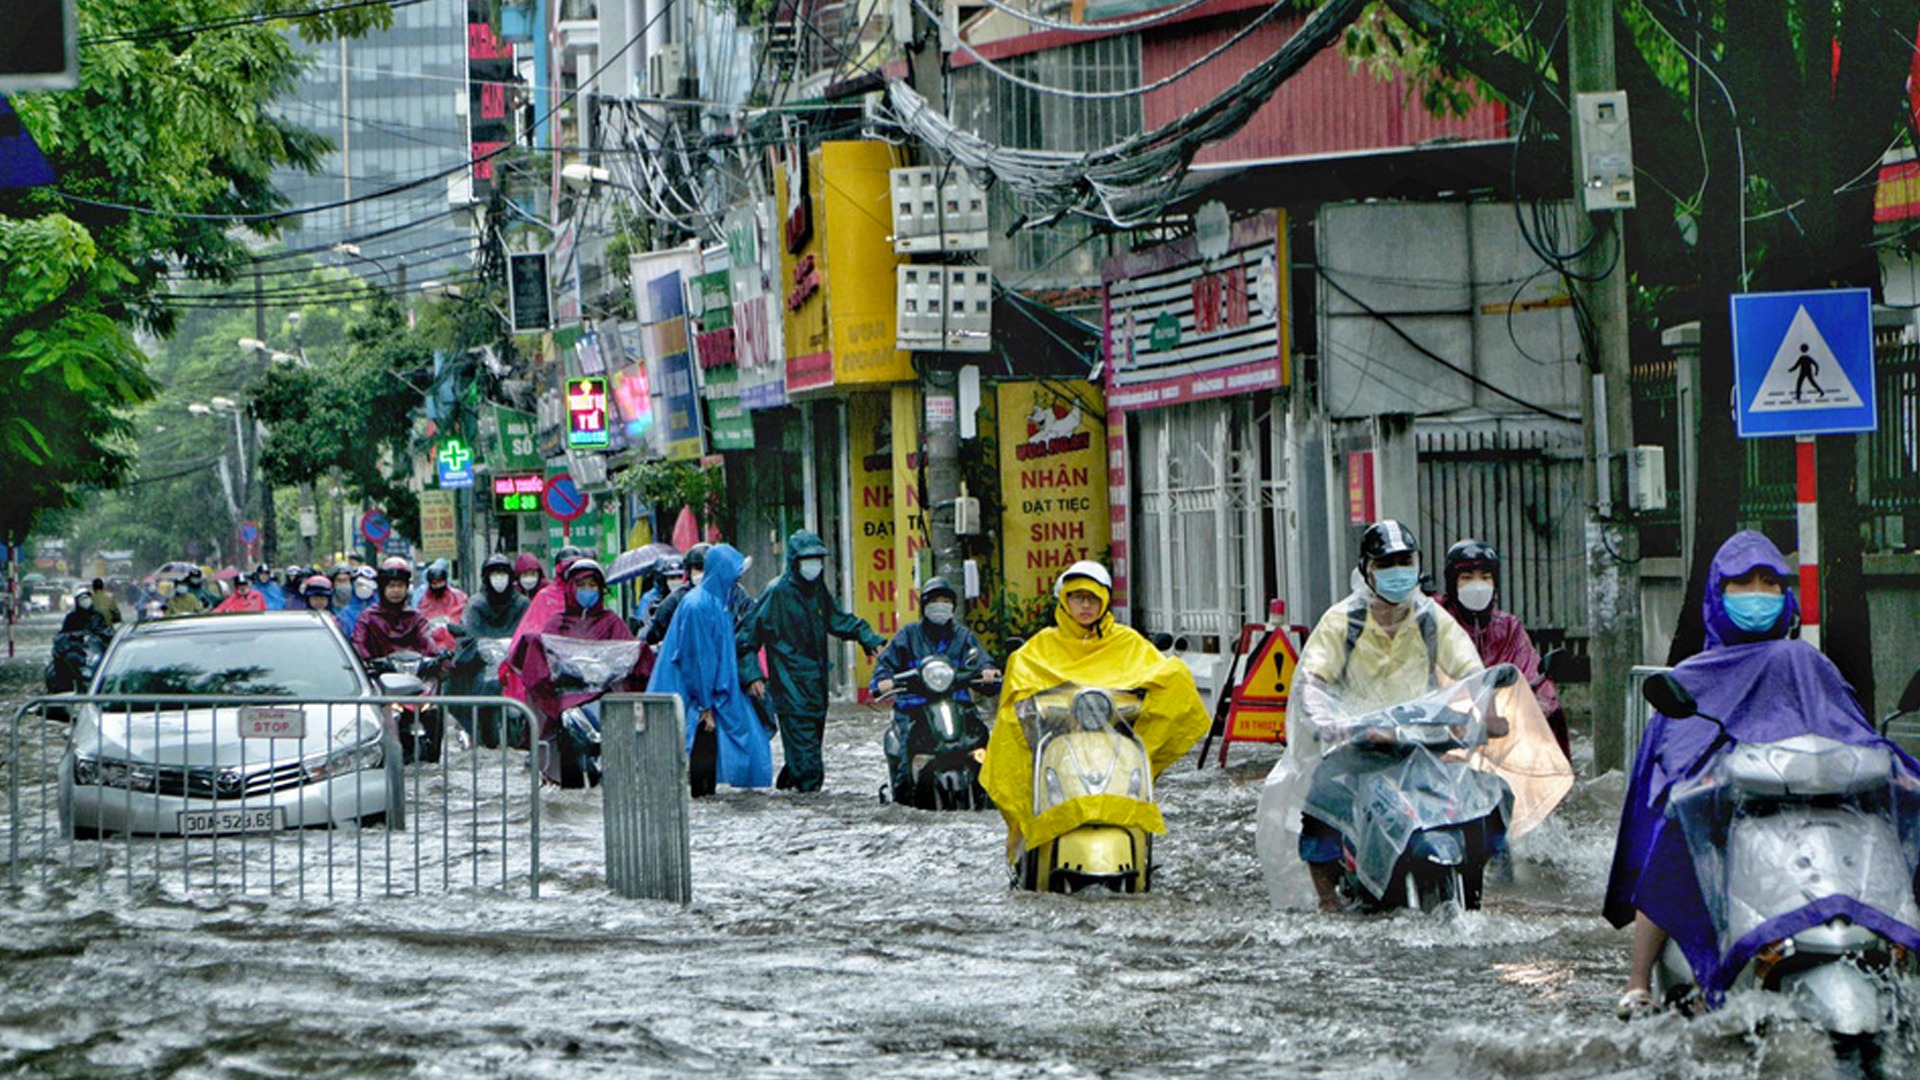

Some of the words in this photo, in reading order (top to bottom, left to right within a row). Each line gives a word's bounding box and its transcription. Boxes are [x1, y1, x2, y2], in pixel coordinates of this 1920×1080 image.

[1021, 464, 1088, 492] NHẬN
[1031, 521, 1084, 542] SINH
[254, 721, 289, 733] STOP
